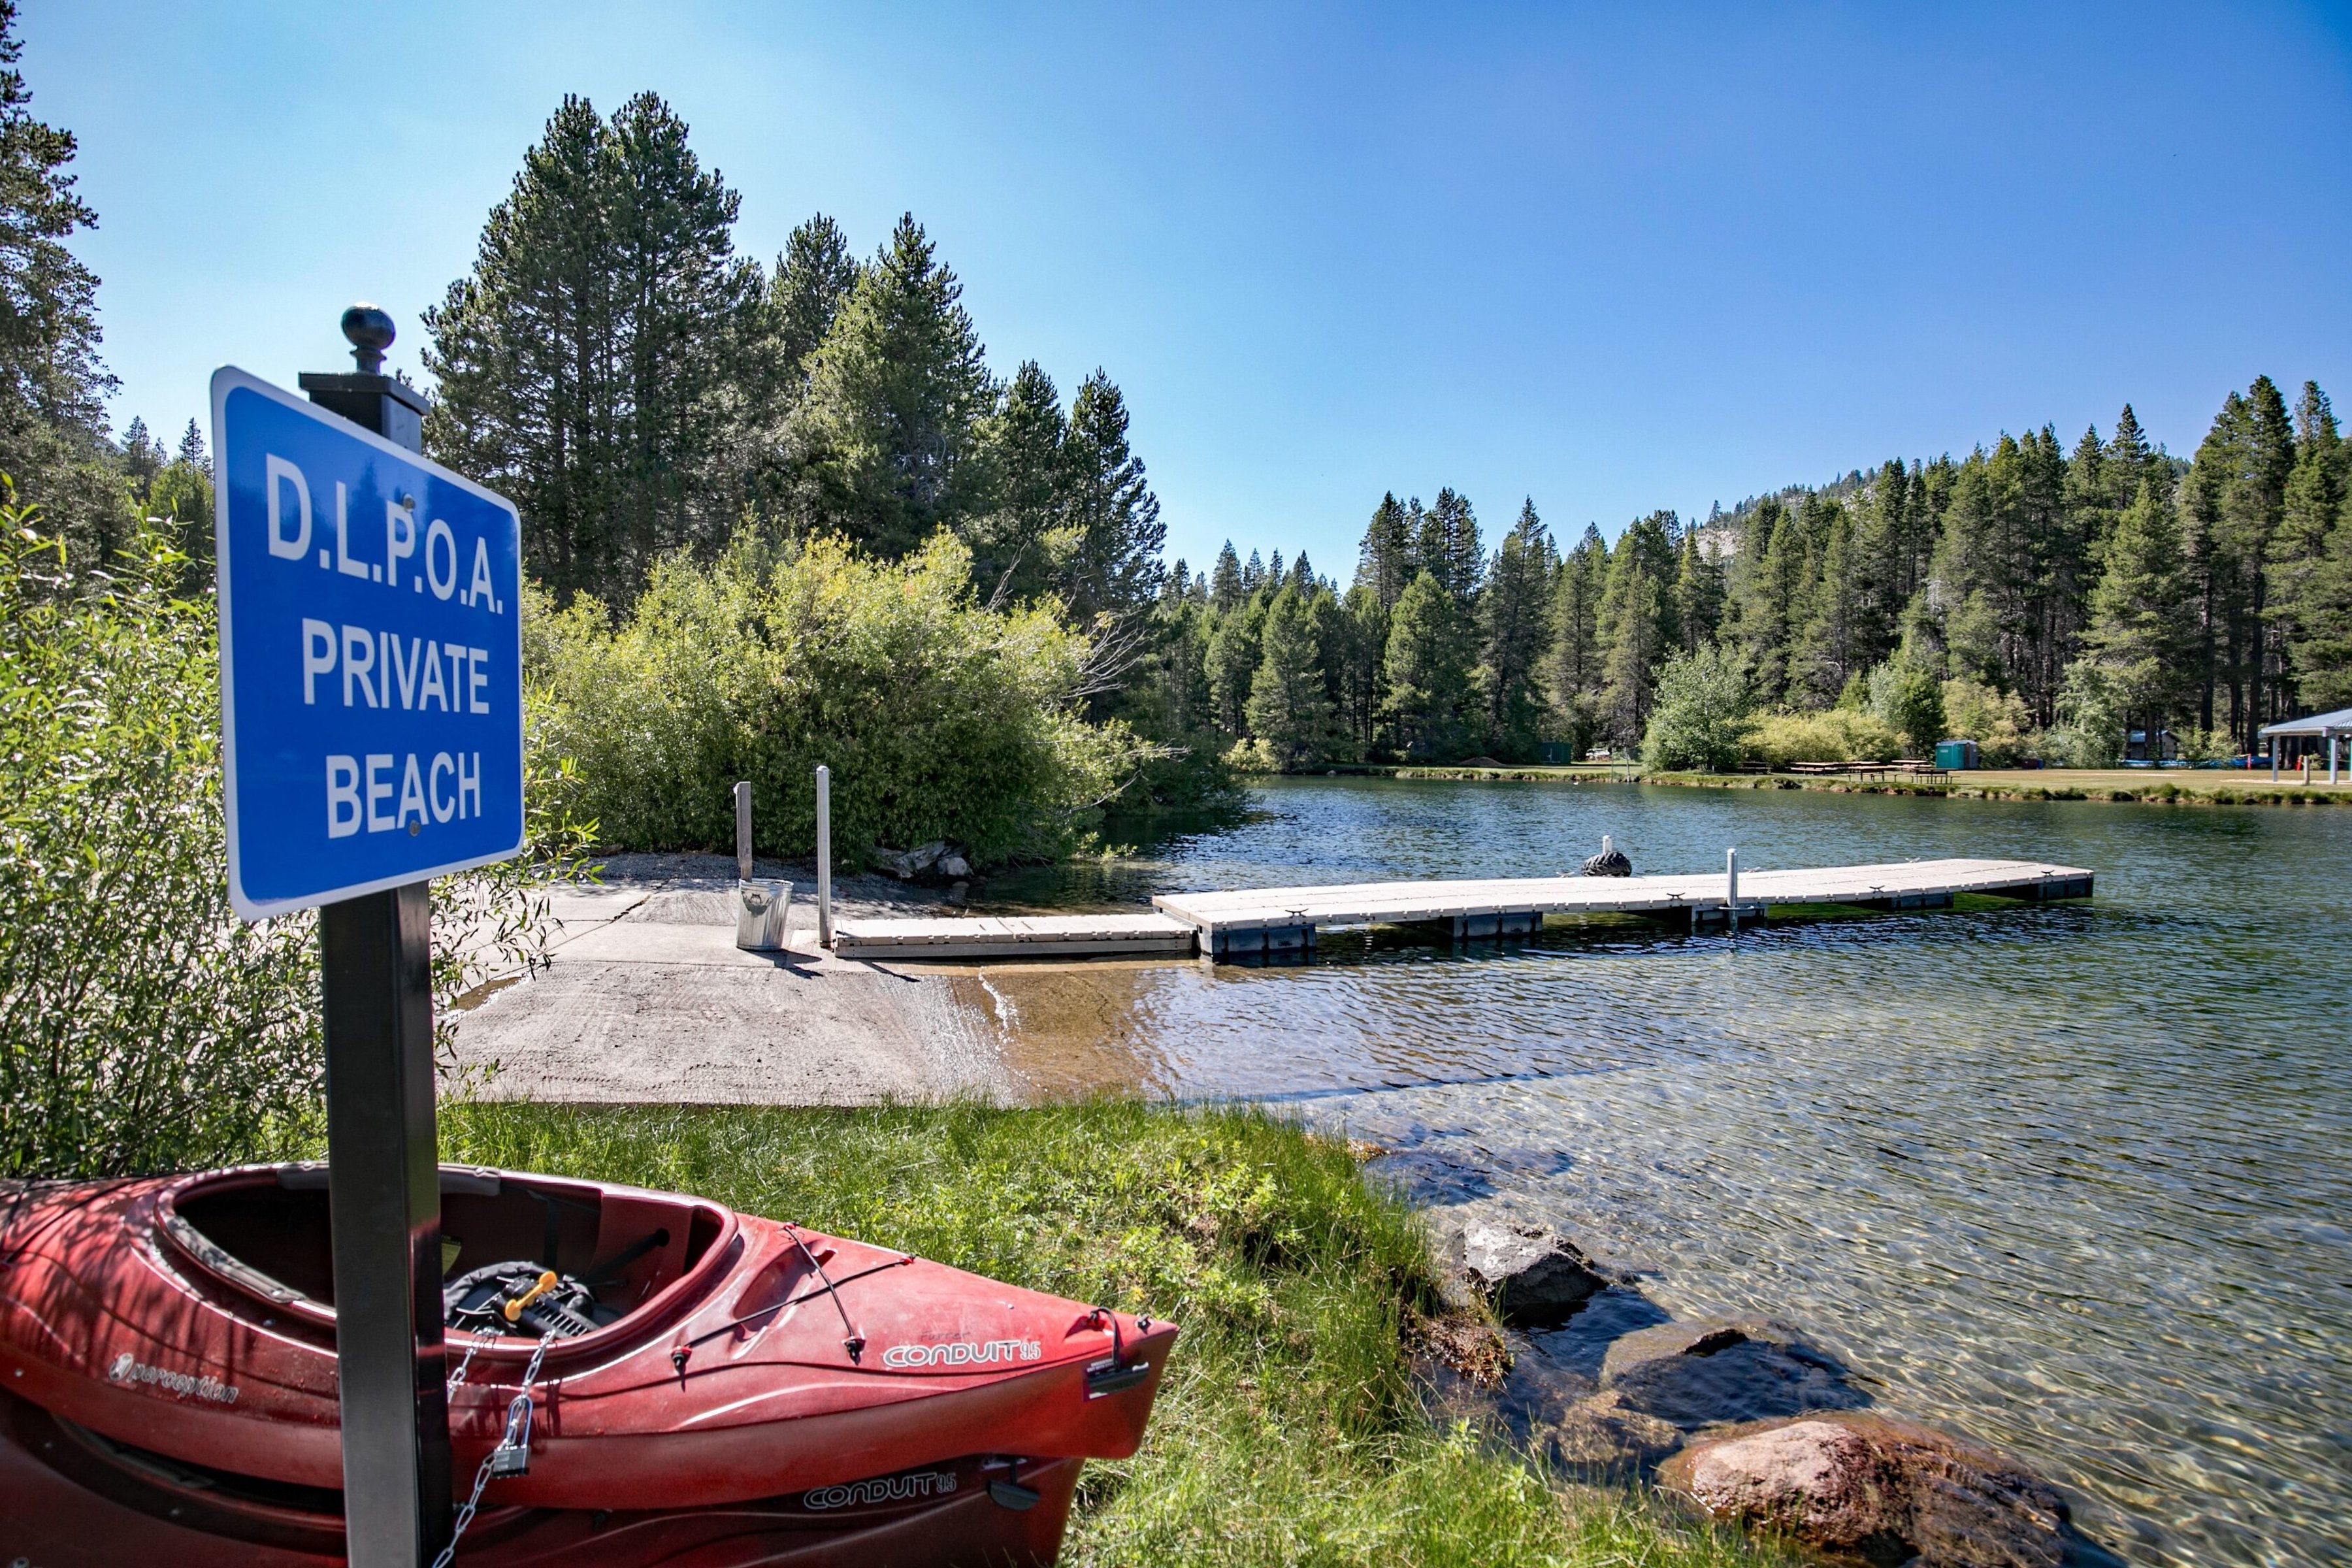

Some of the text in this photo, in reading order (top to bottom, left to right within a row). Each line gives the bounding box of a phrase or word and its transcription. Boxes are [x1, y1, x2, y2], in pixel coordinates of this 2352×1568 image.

[267, 453, 502, 614] D.L.P.O.A.
[302, 618, 489, 714] PRIVATE
[326, 752, 481, 839] BEACH
[1020, 1341, 1041, 1360] 9.5
[126, 1363, 238, 1403] perception
[936, 1473, 956, 1493] 9.5
